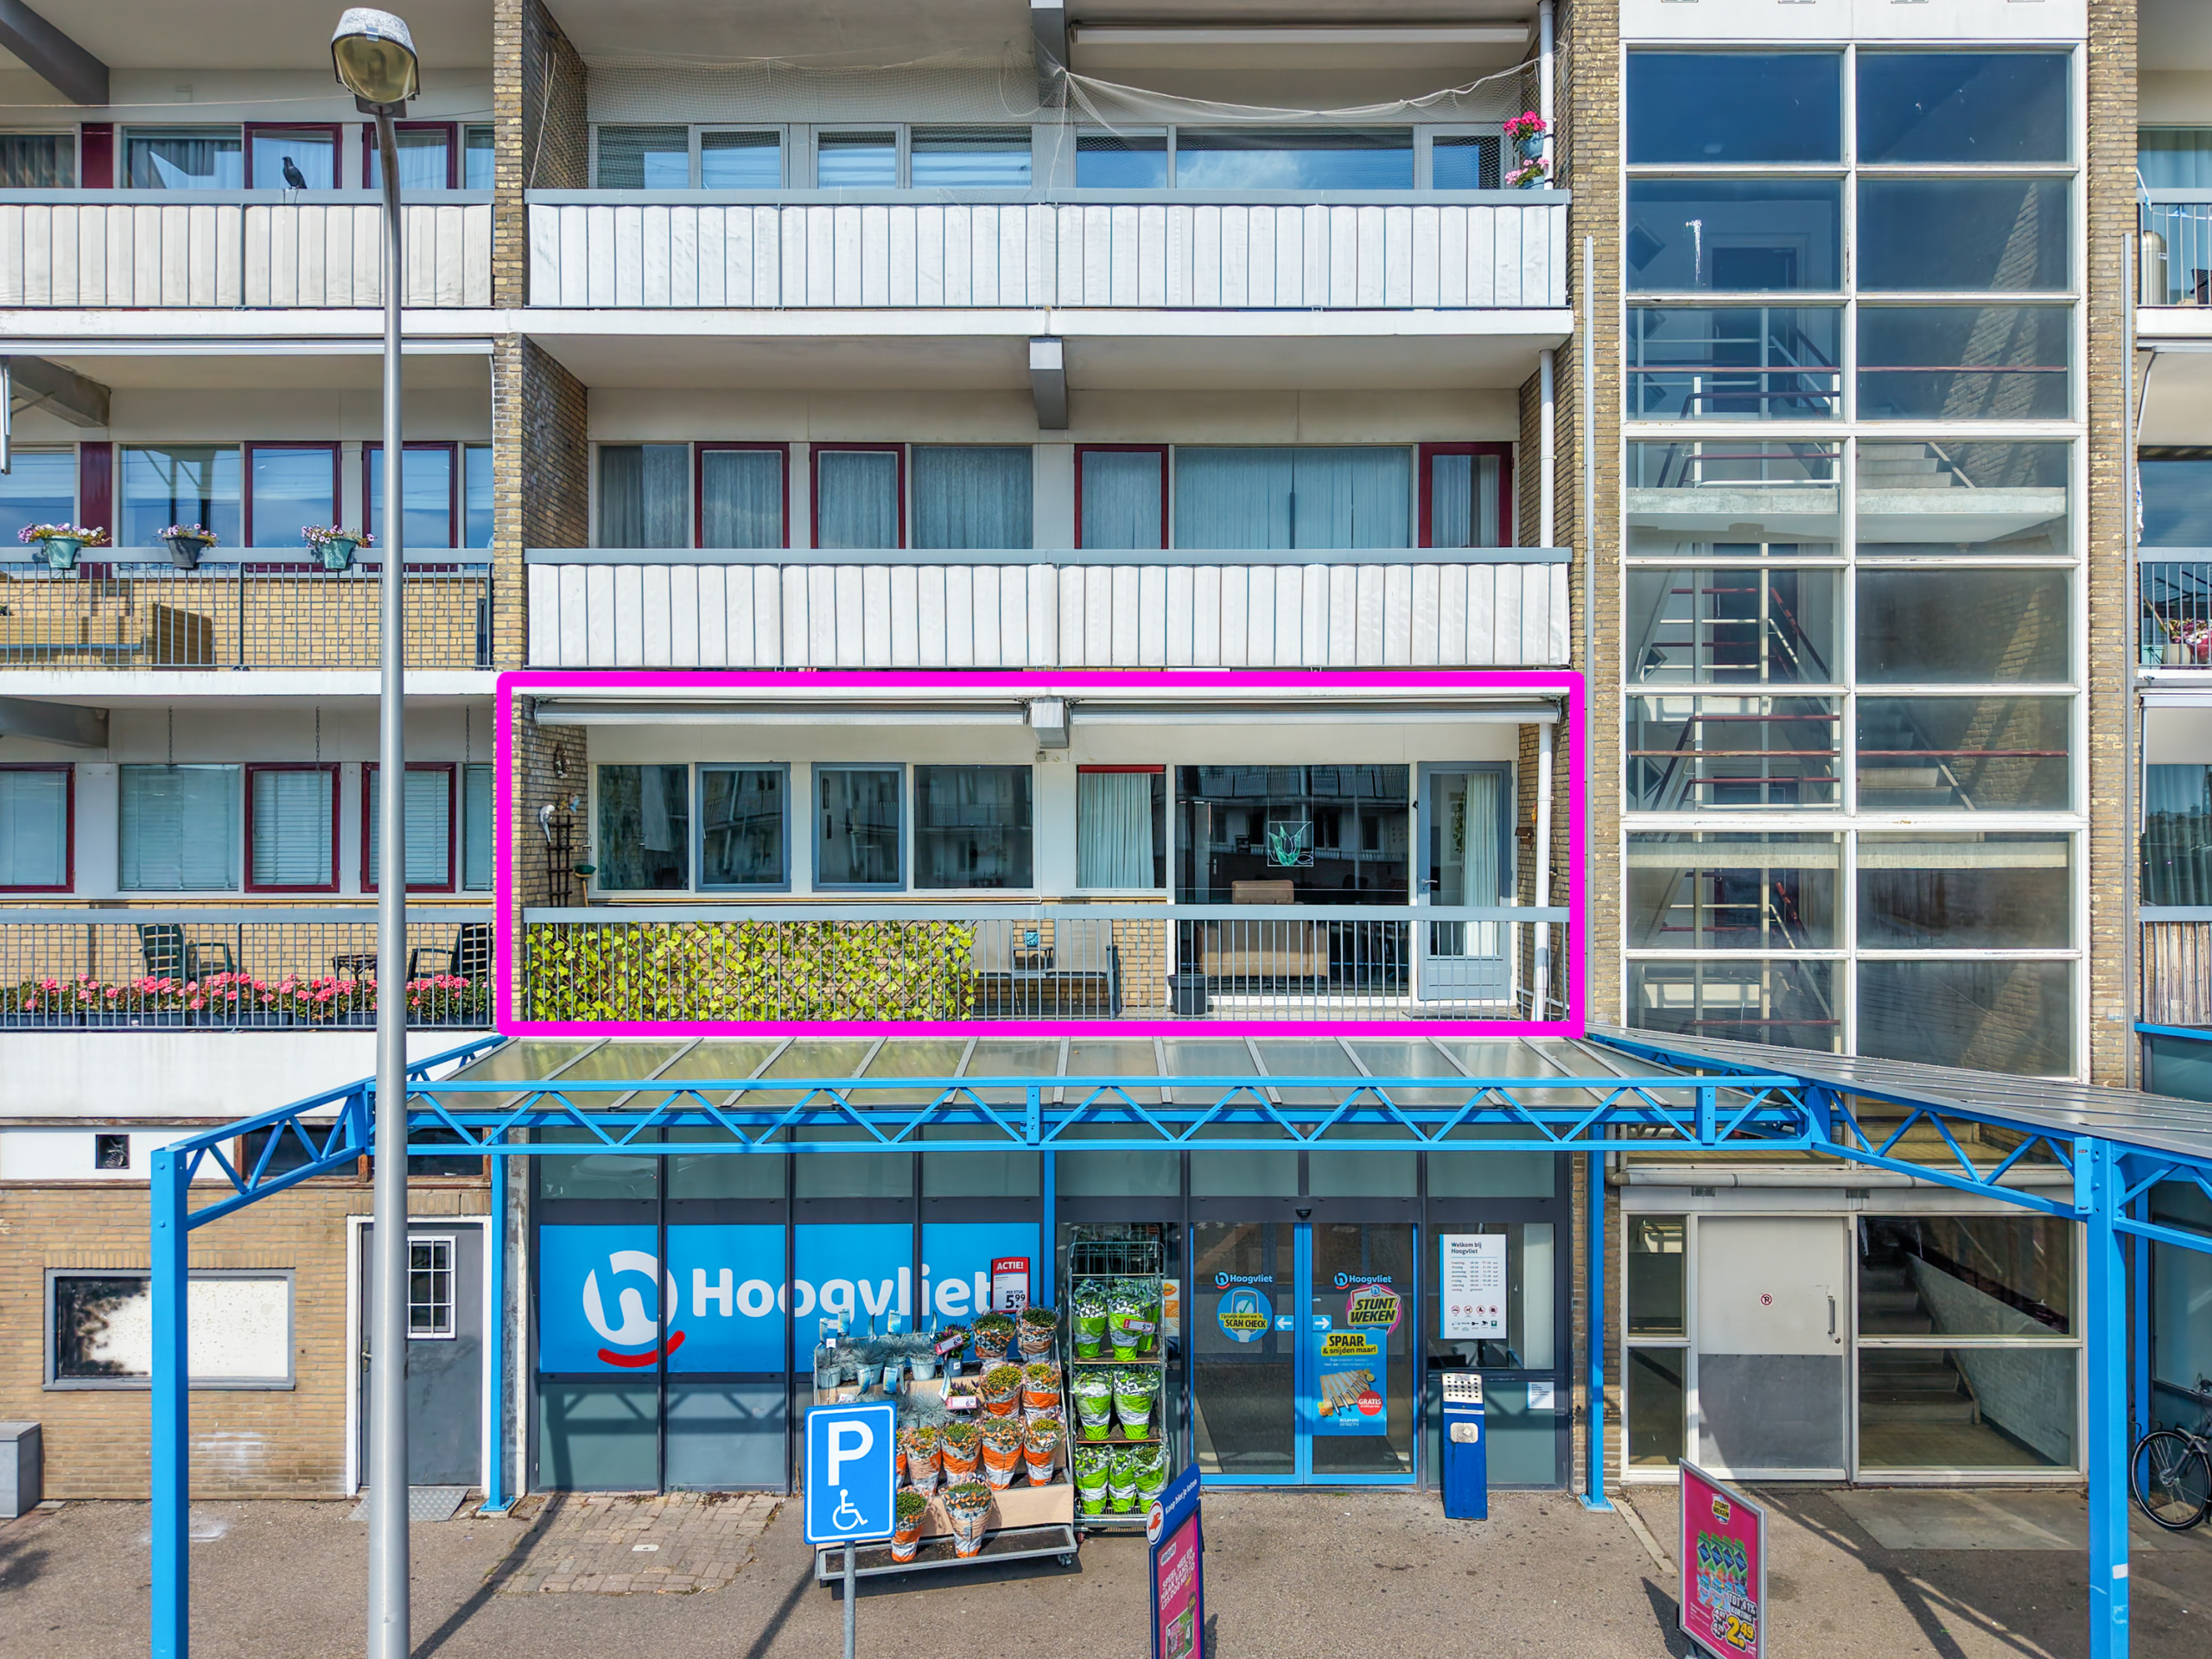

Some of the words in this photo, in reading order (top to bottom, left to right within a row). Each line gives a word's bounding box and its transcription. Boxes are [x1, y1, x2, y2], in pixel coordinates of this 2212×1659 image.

[996, 1261, 1024, 1270] ACTIE!
[1230, 1274, 1273, 1284] Hoogvliet
[1349, 1274, 1392, 1284] Hoogvliet
[692, 1264, 991, 1329] Hoogvliet
[1355, 1297, 1395, 1310] STUNT
[1351, 1309, 1395, 1323] WEKEN
[1225, 1319, 1243, 1327] SCAN
[1244, 1319, 1267, 1328] CHECK
[1328, 1335, 1364, 1347] SPAAR
[1329, 1346, 1355, 1356] snijden
[1356, 1345, 1376, 1354] maar!
[827, 1420, 874, 1486] P
[1728, 1593, 1740, 1607] TOT
[1726, 1616, 1754, 1648] 2.49
